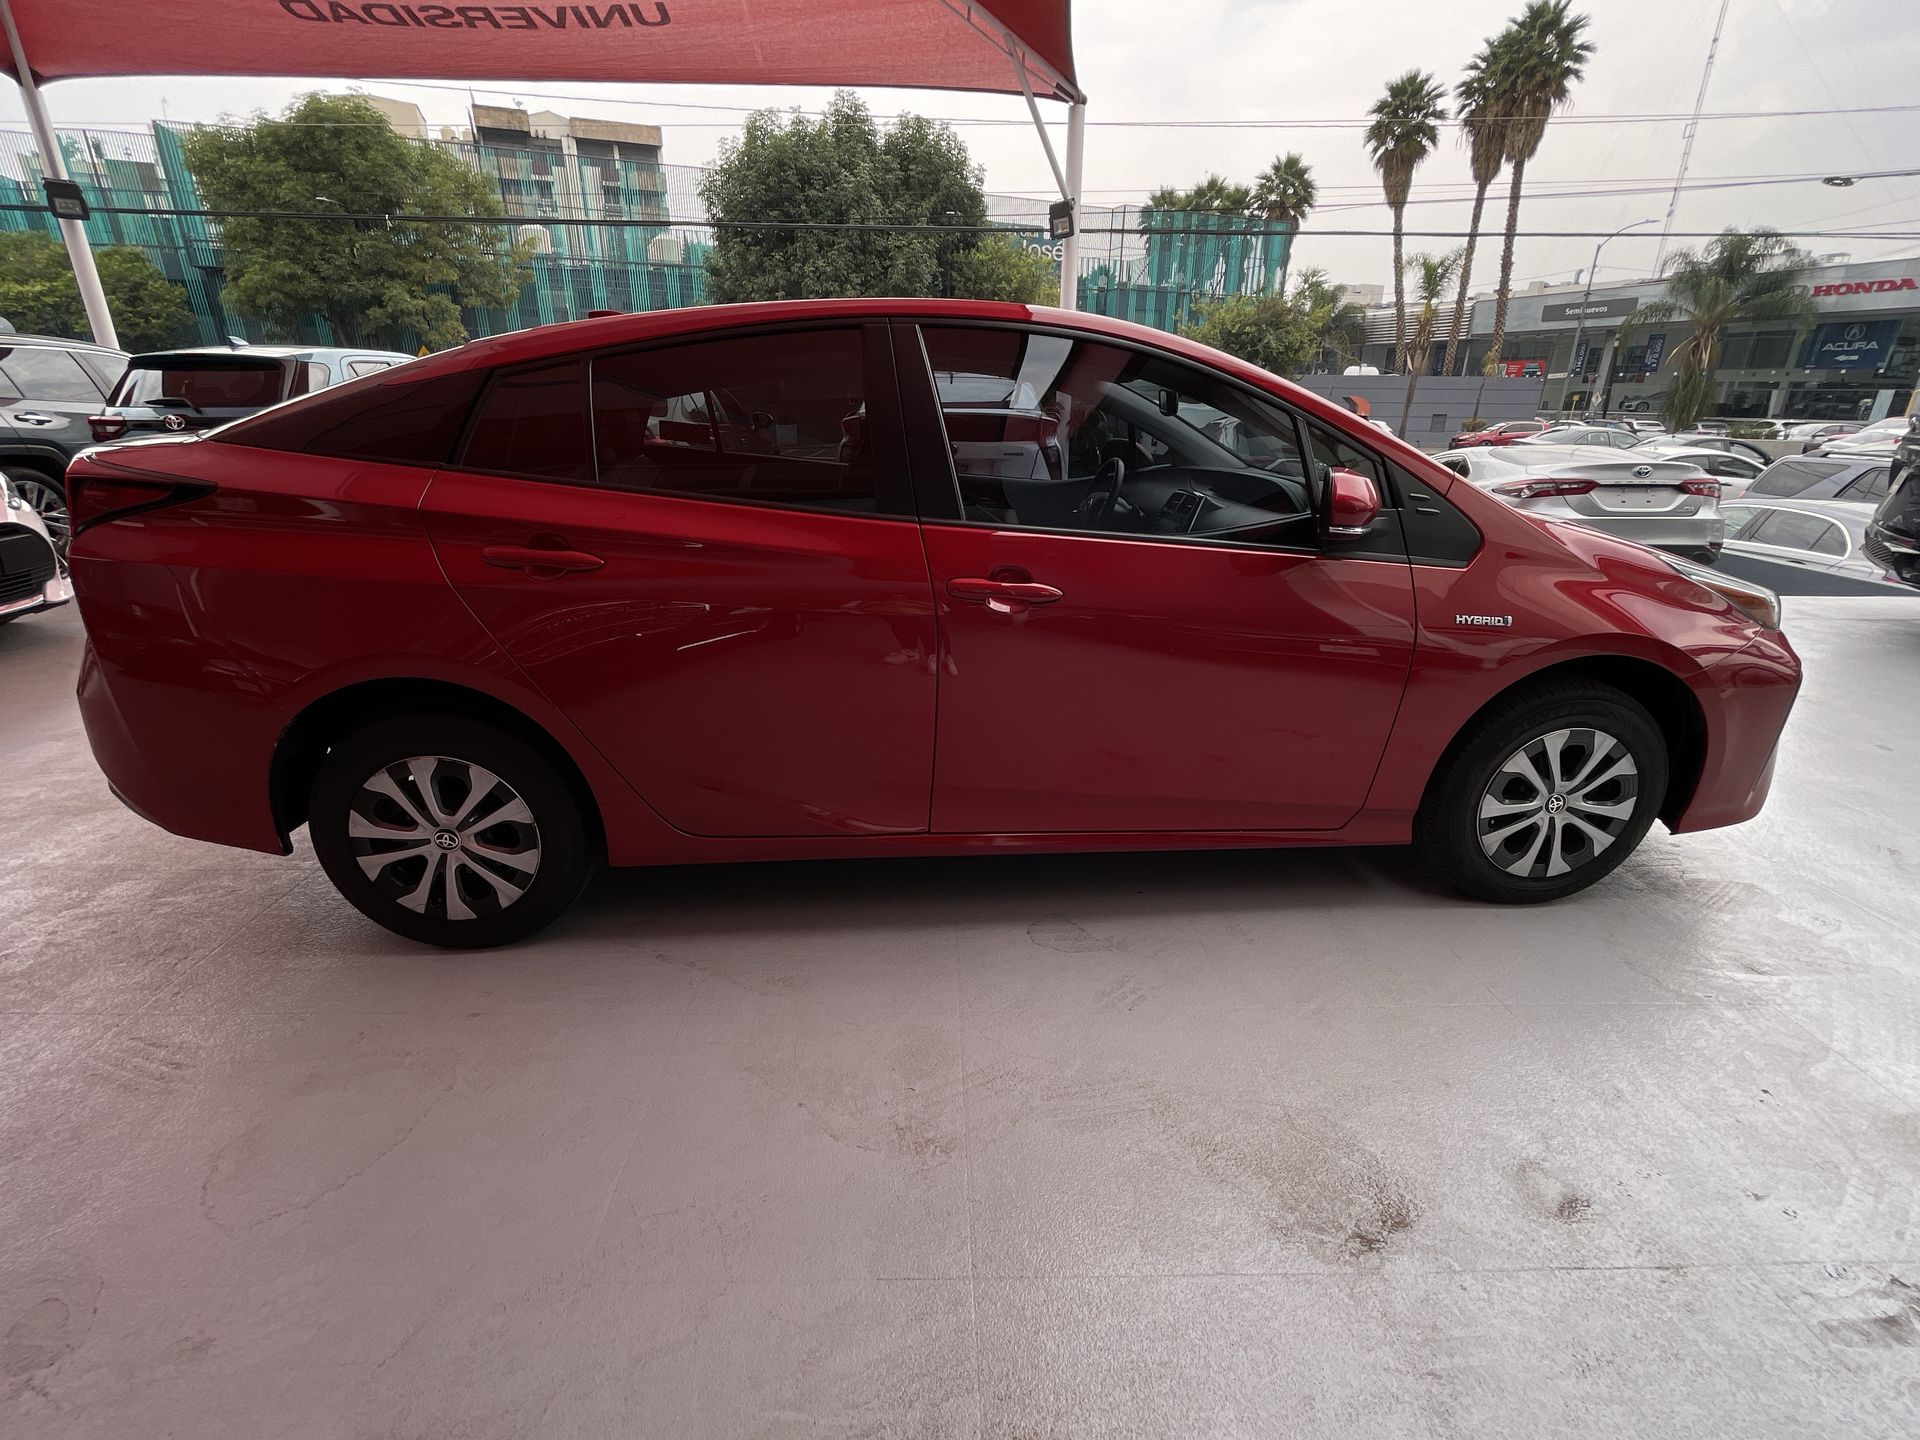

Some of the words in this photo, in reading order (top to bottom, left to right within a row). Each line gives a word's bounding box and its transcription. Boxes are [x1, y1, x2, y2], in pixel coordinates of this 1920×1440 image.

[1811, 278, 1918, 297] HONDA
[1821, 341, 1879, 352] ACURA
[1456, 614, 1505, 626] HYBRID
